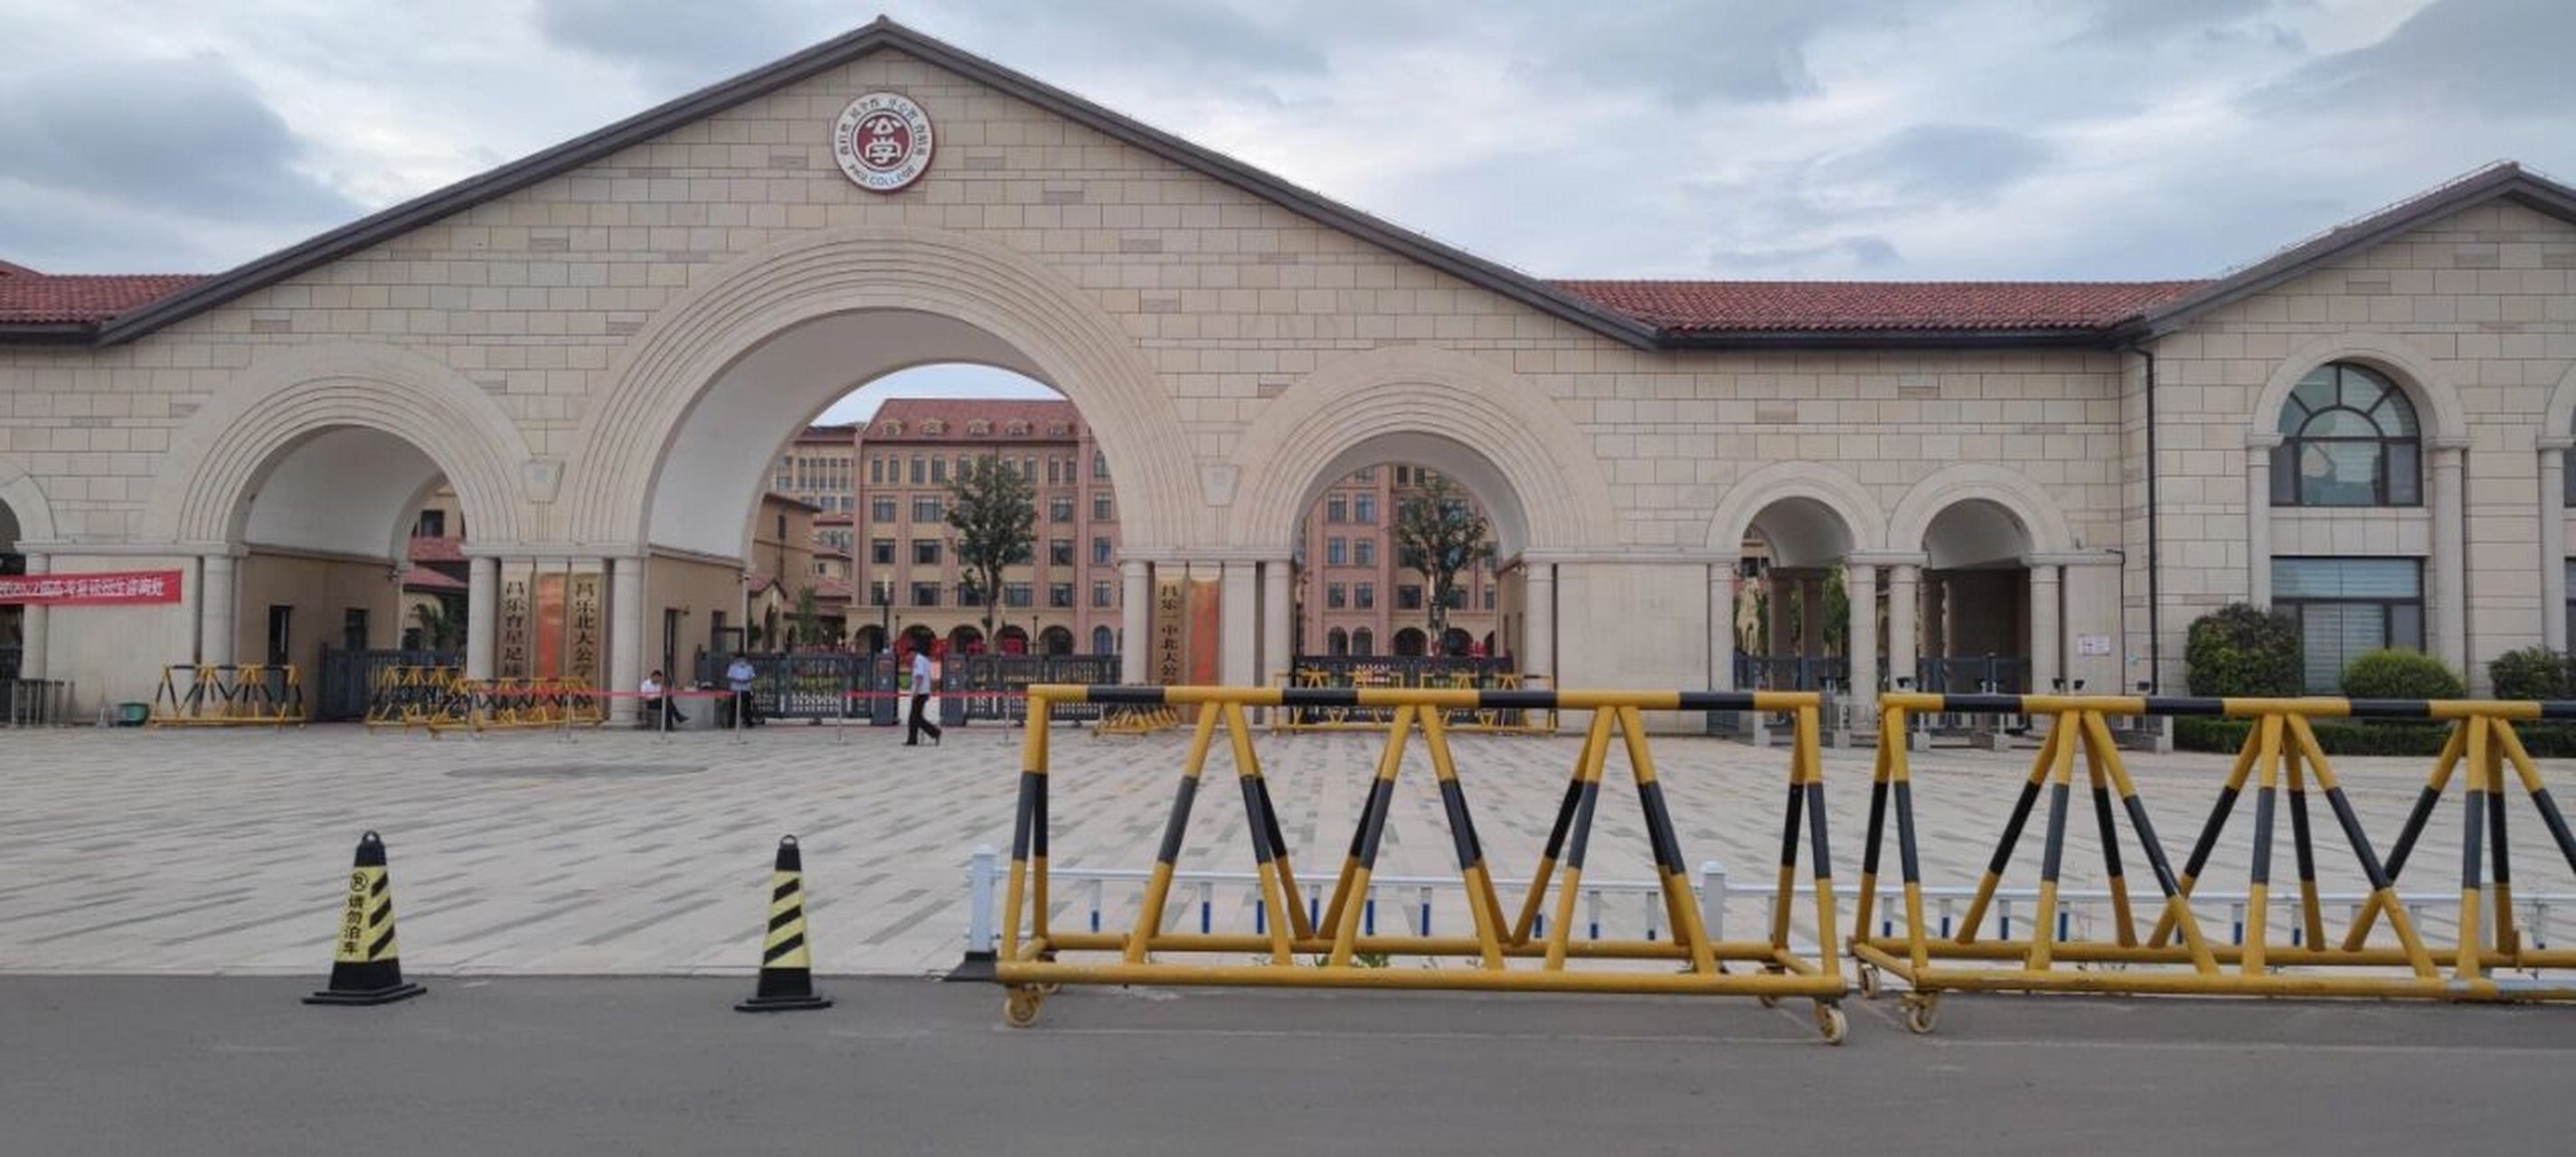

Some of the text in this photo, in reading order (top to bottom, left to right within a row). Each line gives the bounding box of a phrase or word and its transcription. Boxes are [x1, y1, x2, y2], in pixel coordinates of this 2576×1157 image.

[864, 117, 902, 165] 公学
[869, 165, 914, 185] COLLEGE
[343, 895, 364, 956] 请勿泊车
